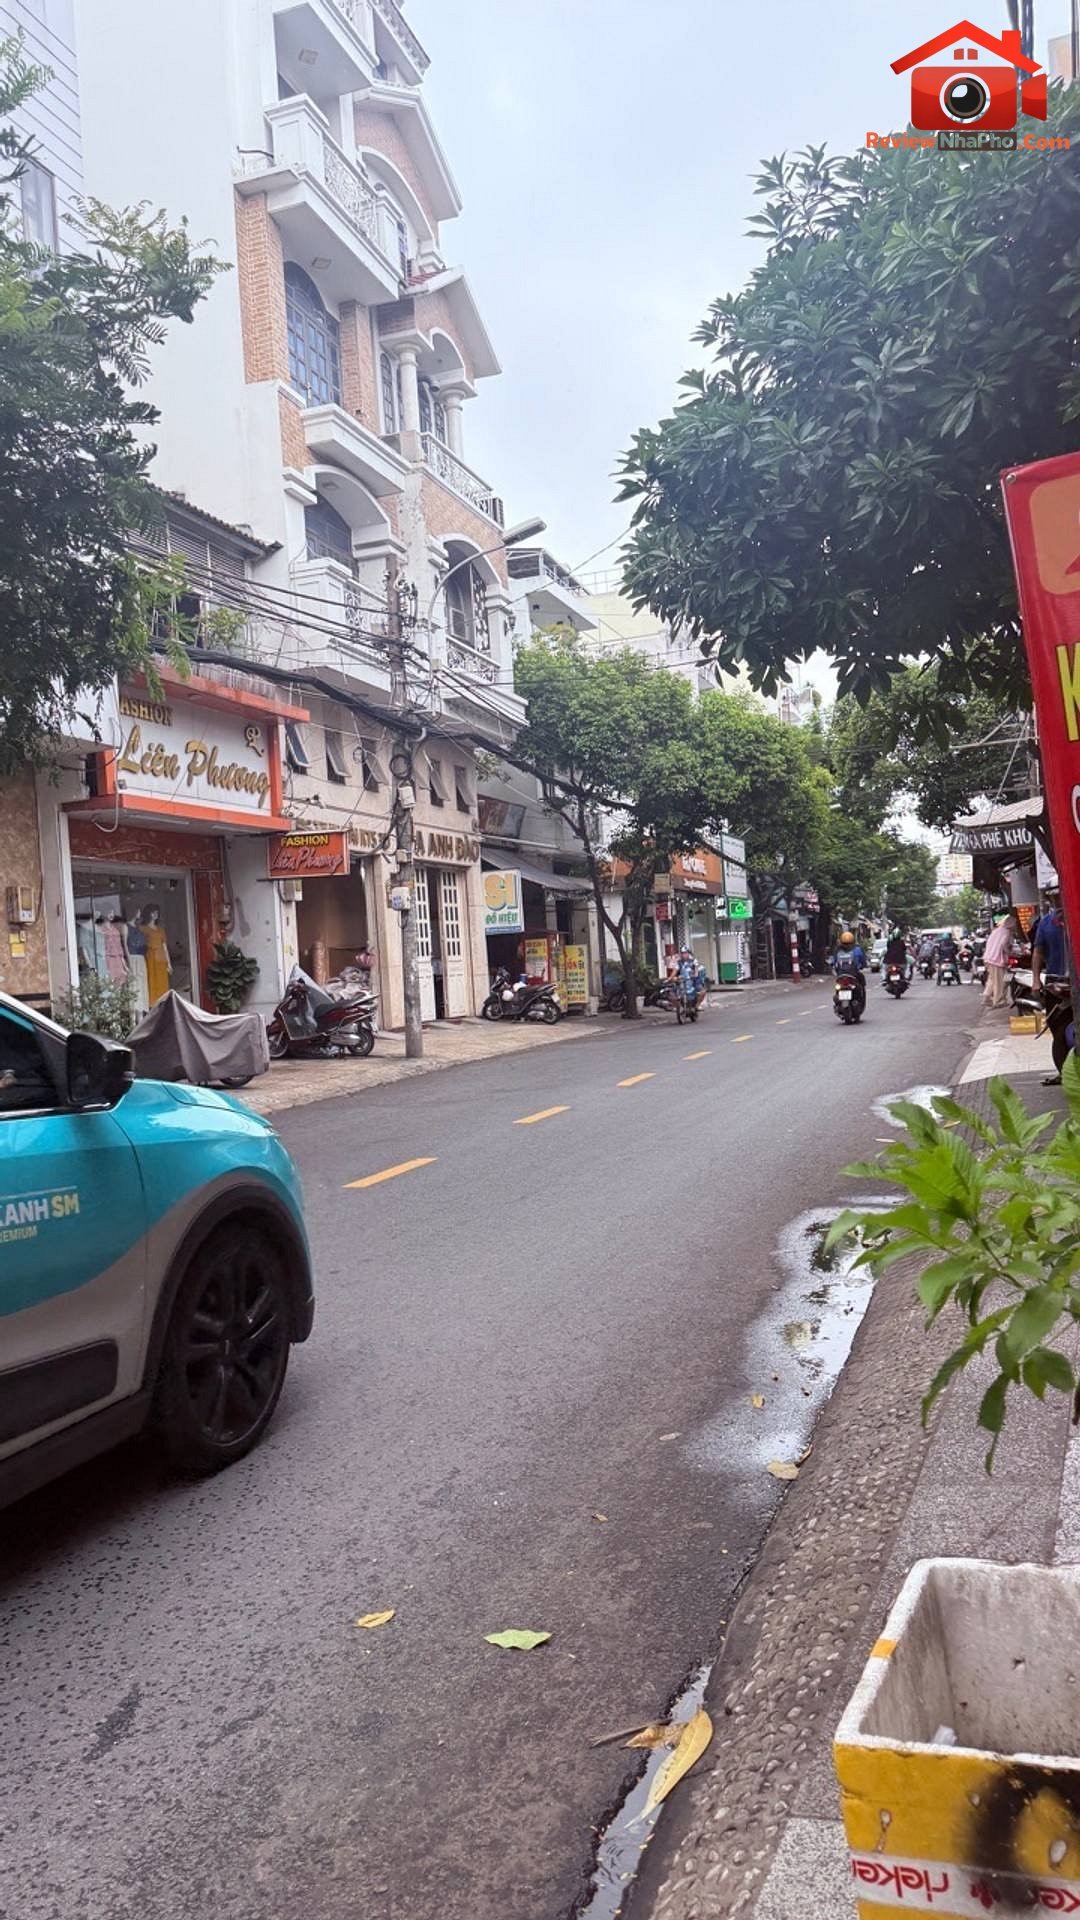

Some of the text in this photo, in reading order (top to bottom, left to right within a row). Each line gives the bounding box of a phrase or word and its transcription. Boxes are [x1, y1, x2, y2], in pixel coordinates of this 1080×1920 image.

[120, 694, 176, 727] ASHION
[280, 834, 329, 848] FASHION
[51, 1193, 80, 1218] SM
